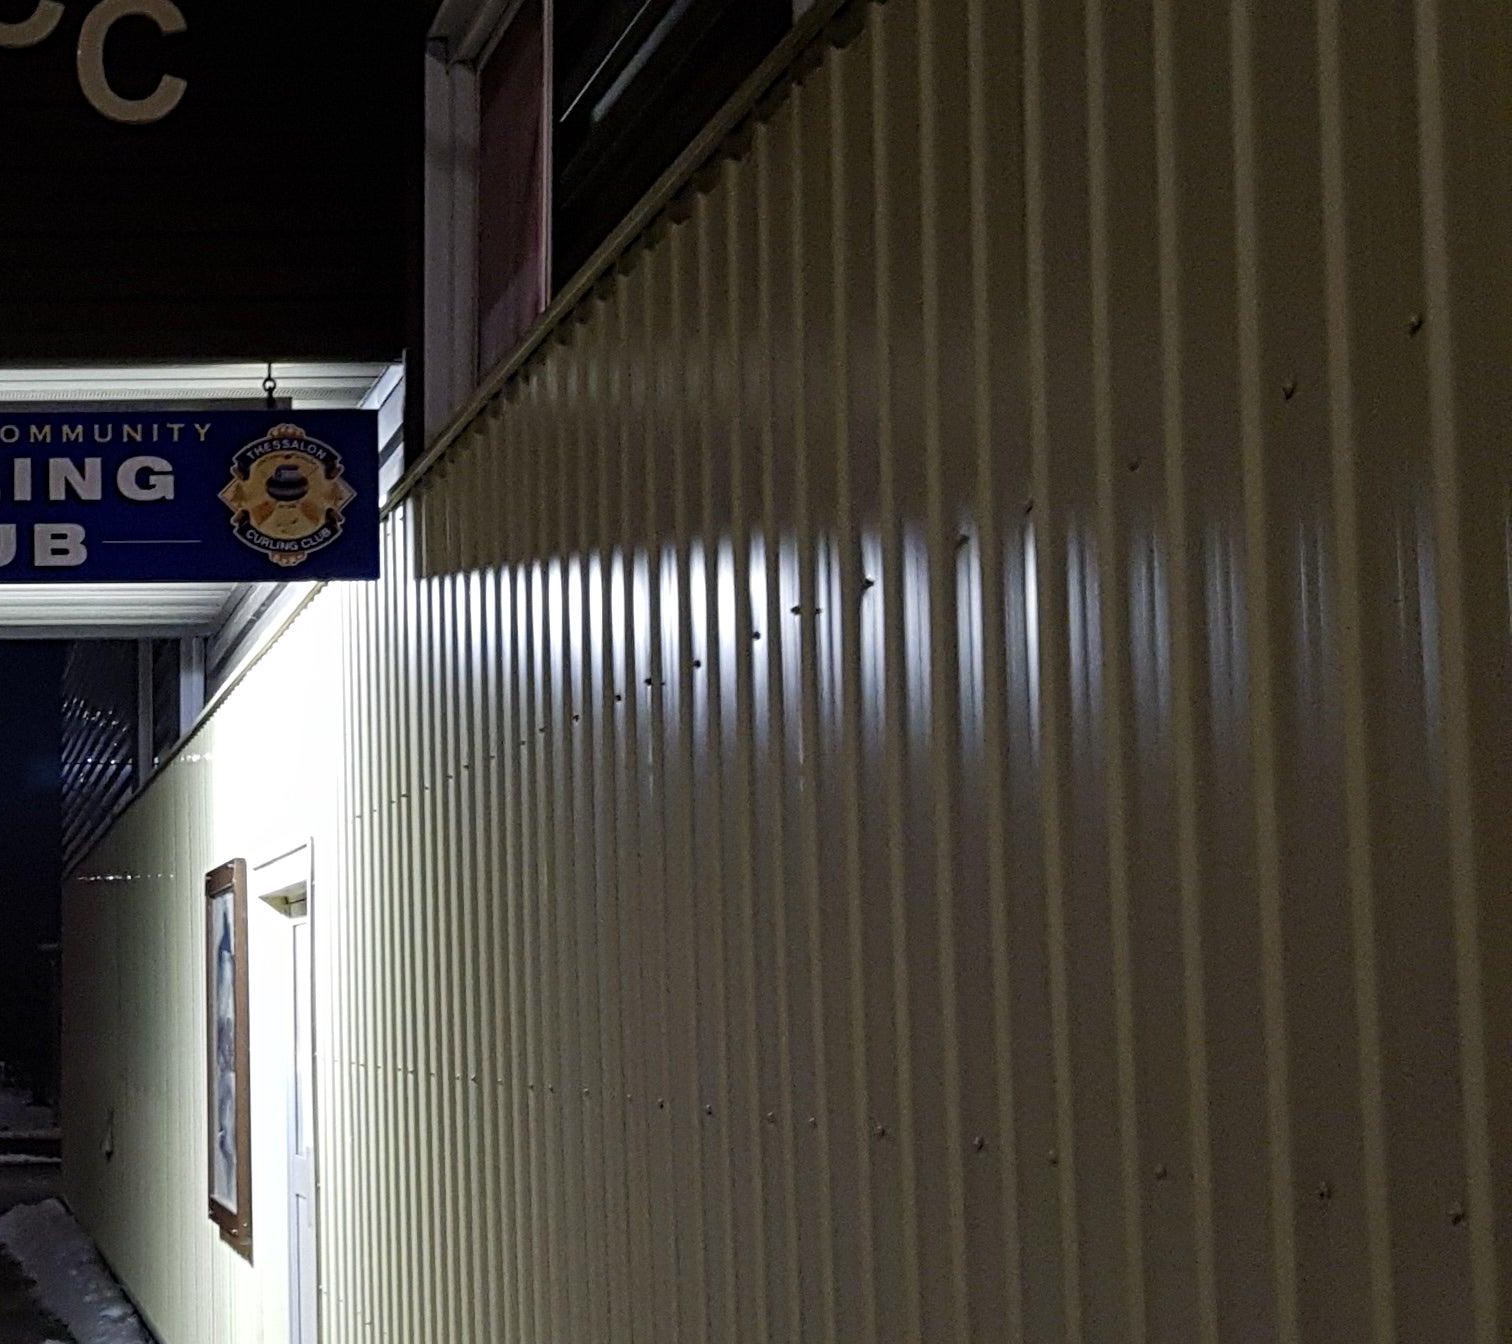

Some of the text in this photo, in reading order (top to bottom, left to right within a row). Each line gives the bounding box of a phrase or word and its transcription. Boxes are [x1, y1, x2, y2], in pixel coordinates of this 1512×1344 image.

[246, 438, 328, 460] THESSALON
[245, 527, 332, 552] CURLING CLUB
